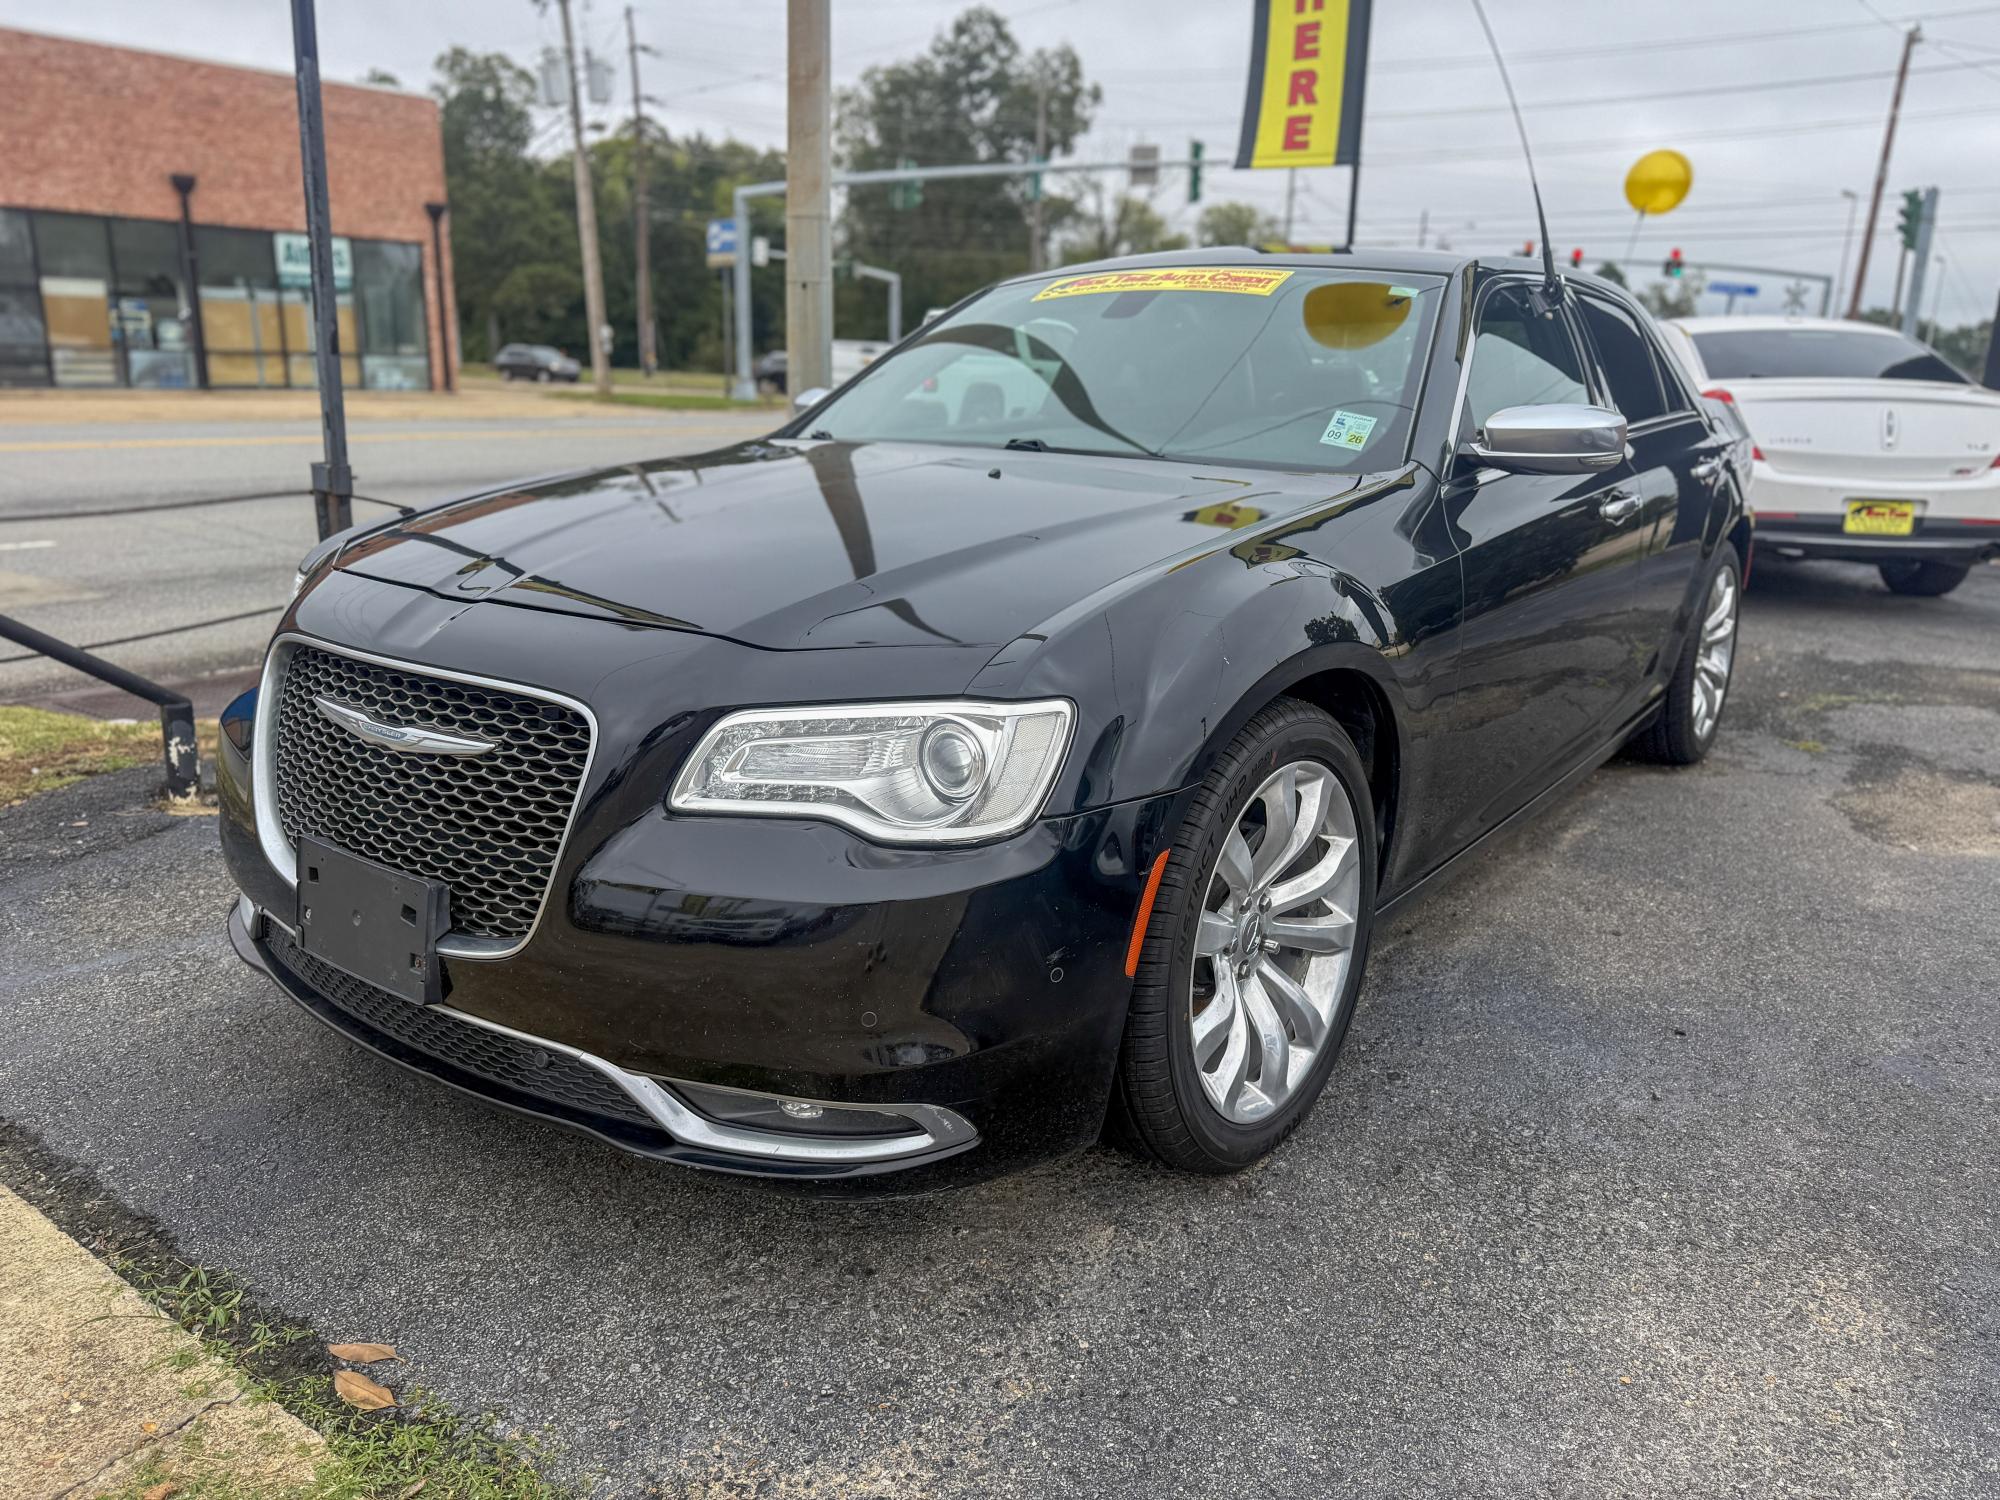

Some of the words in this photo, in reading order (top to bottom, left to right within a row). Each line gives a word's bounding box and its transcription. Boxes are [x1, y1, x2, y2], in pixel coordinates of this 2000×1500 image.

[1327, 430, 1342, 440] 09
[1348, 434, 1363, 444] 26
[1177, 833, 1215, 966] INSTINCT
